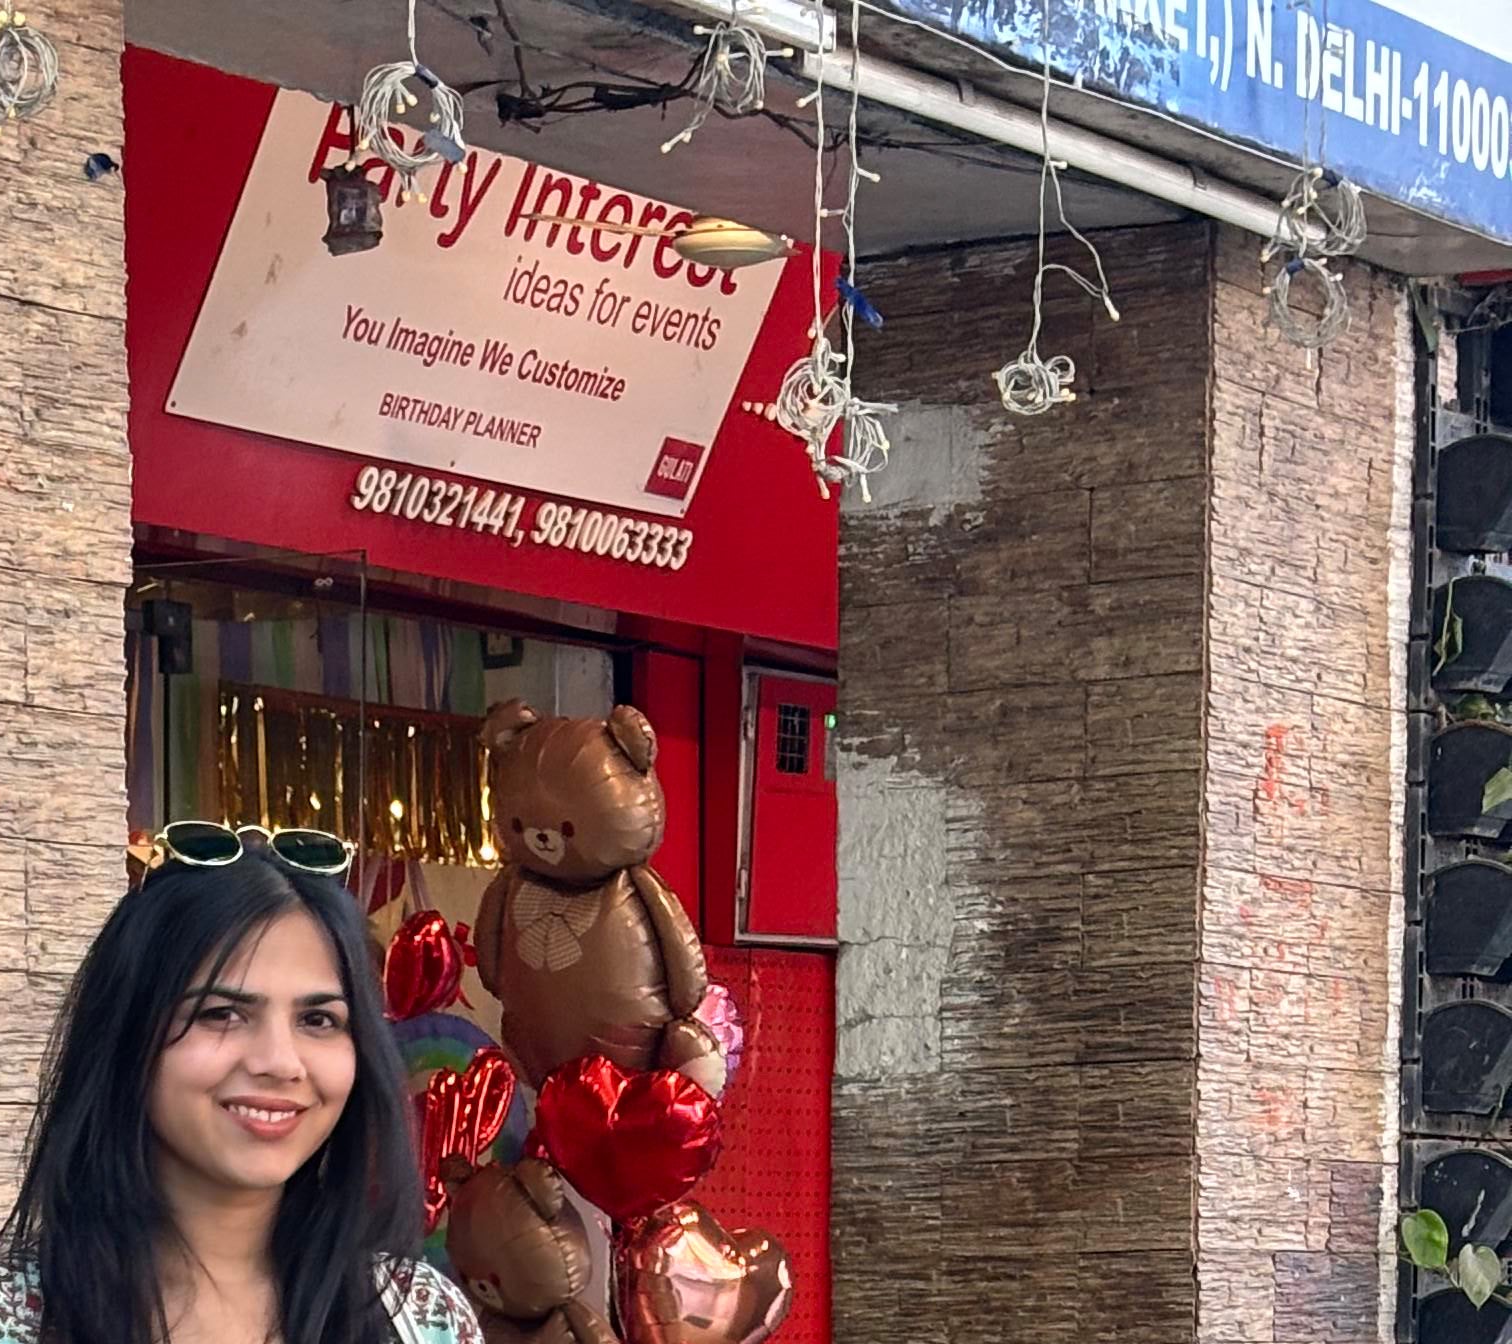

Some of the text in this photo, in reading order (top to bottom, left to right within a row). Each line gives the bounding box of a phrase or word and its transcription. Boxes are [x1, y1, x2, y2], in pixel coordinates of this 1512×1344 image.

[1246, 0, 1284, 89] N.
[1296, 10, 1512, 180] DELHI-11000
[502, 255, 722, 352] ideas for events
[341, 304, 627, 402] You Imagine We Customize
[378, 392, 542, 449] BIRTHDAY PLANNER
[351, 465, 694, 571] 9810321441, 9810063333
